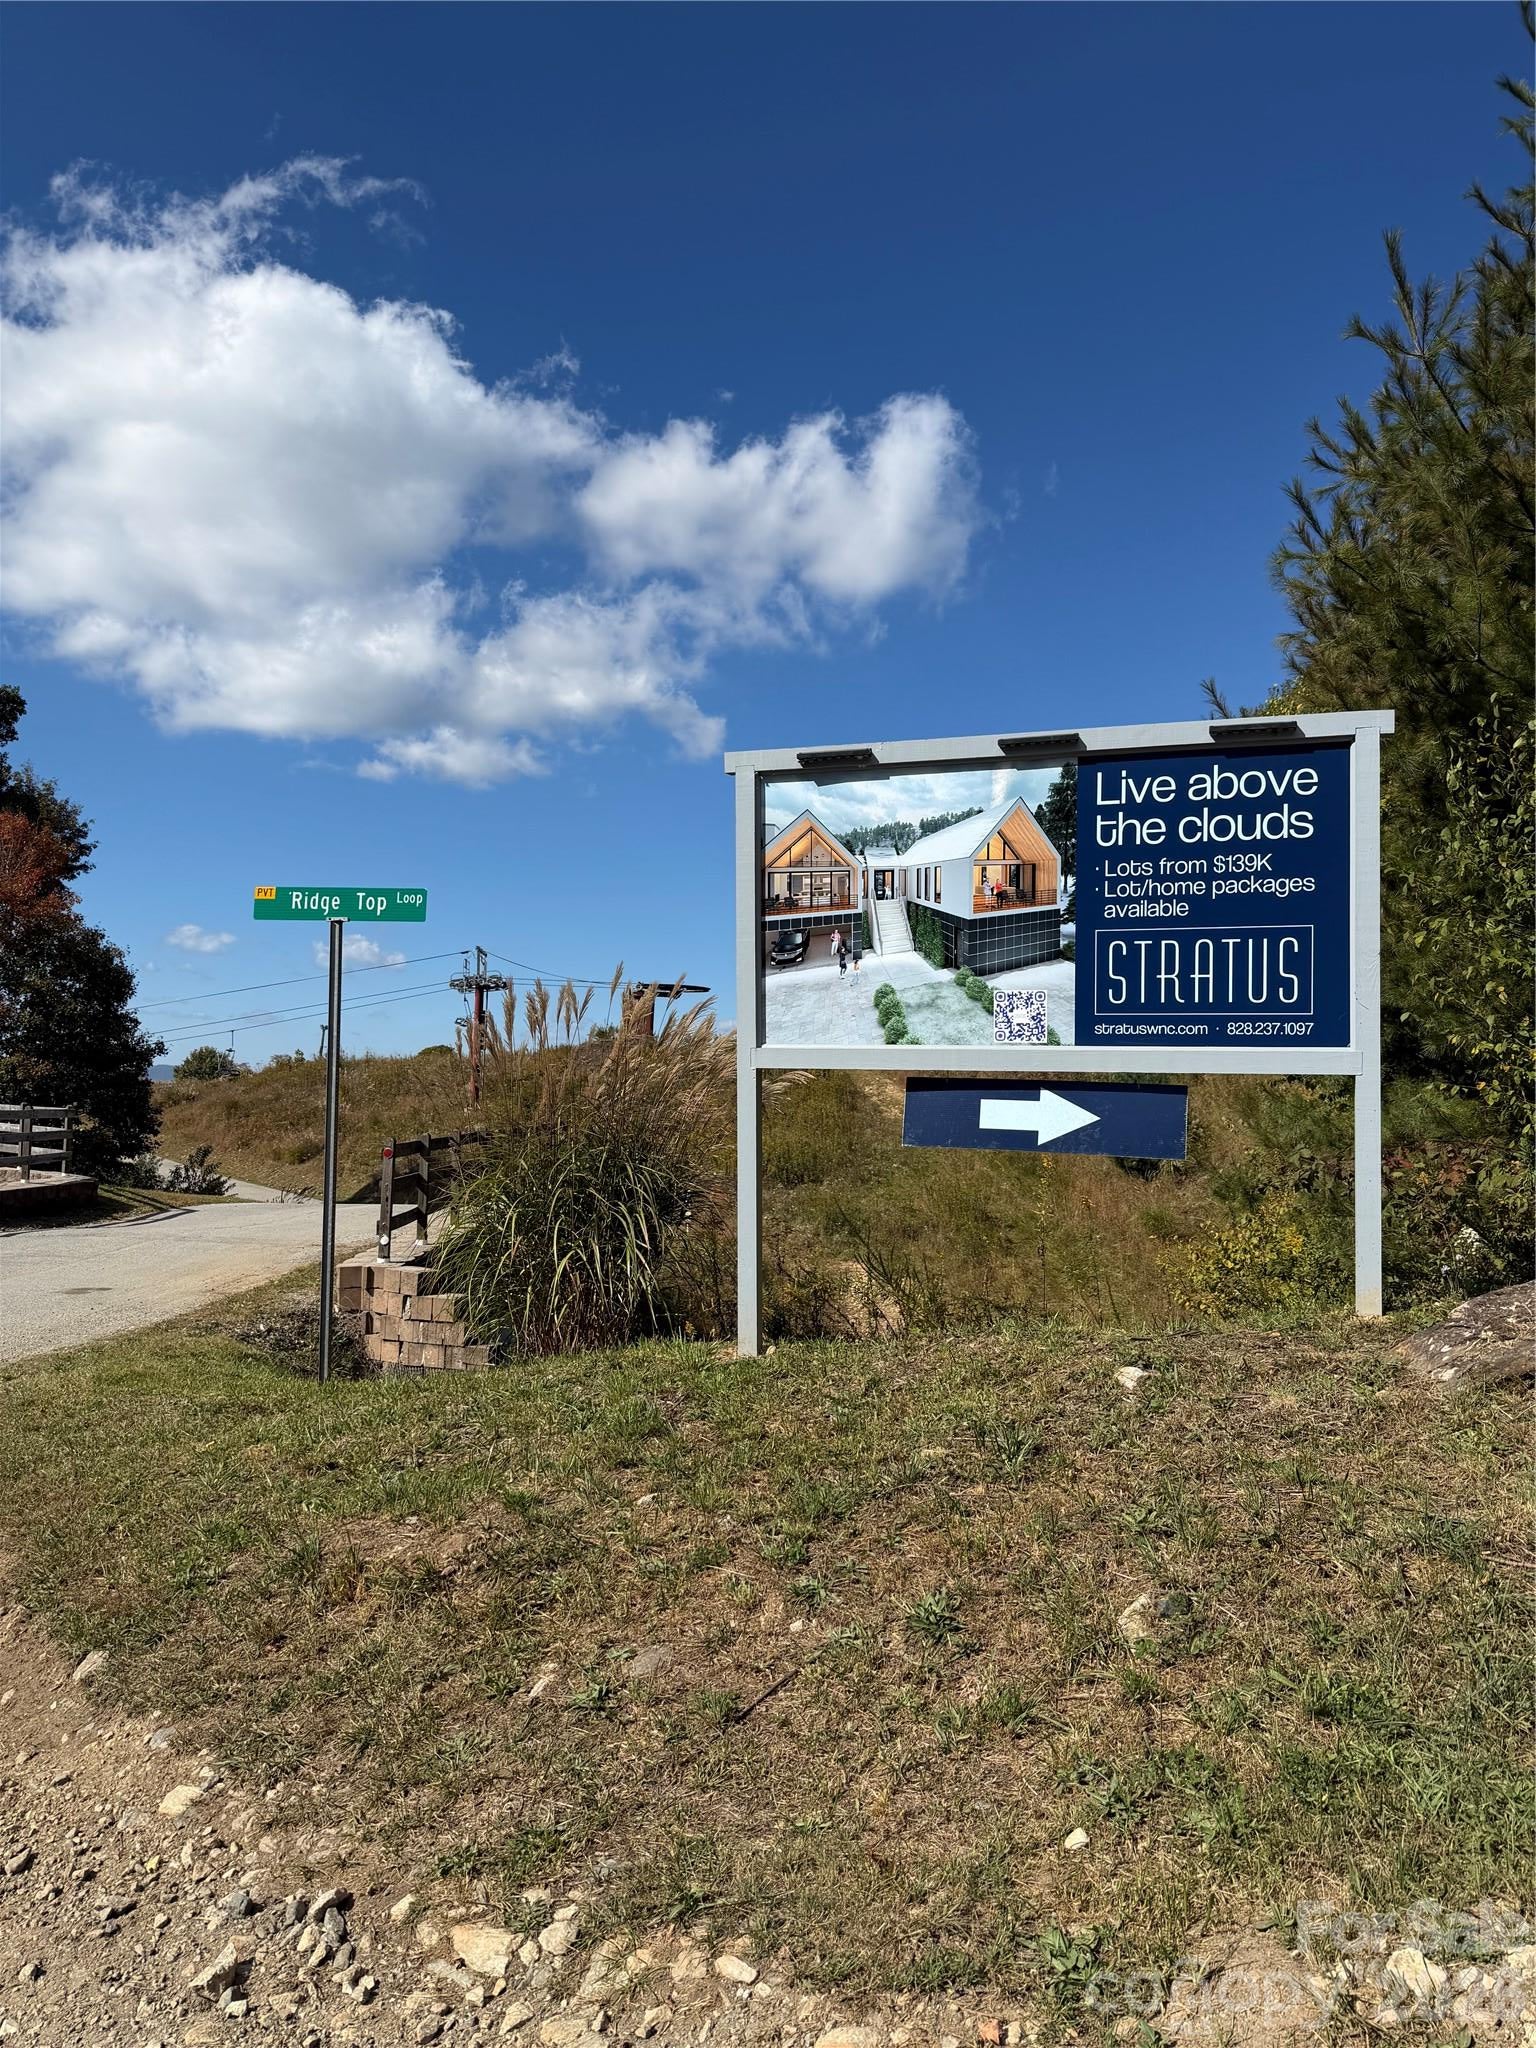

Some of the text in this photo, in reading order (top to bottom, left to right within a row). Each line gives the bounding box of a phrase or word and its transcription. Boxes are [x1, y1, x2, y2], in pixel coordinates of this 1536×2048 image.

[1096, 765, 1319, 806] Live above
[1096, 804, 1315, 847] the clouds
[1104, 853, 1273, 877] Lots from $139K
[257, 887, 274, 898] PVT
[1104, 875, 1316, 900] Lot/home packages
[291, 891, 423, 916] Ridge Top Loop
[1103, 899, 1190, 918] available
[1108, 937, 1299, 1004] STRATUS
[1094, 1022, 1315, 1036] stratuswnc.com 828.237.1097
